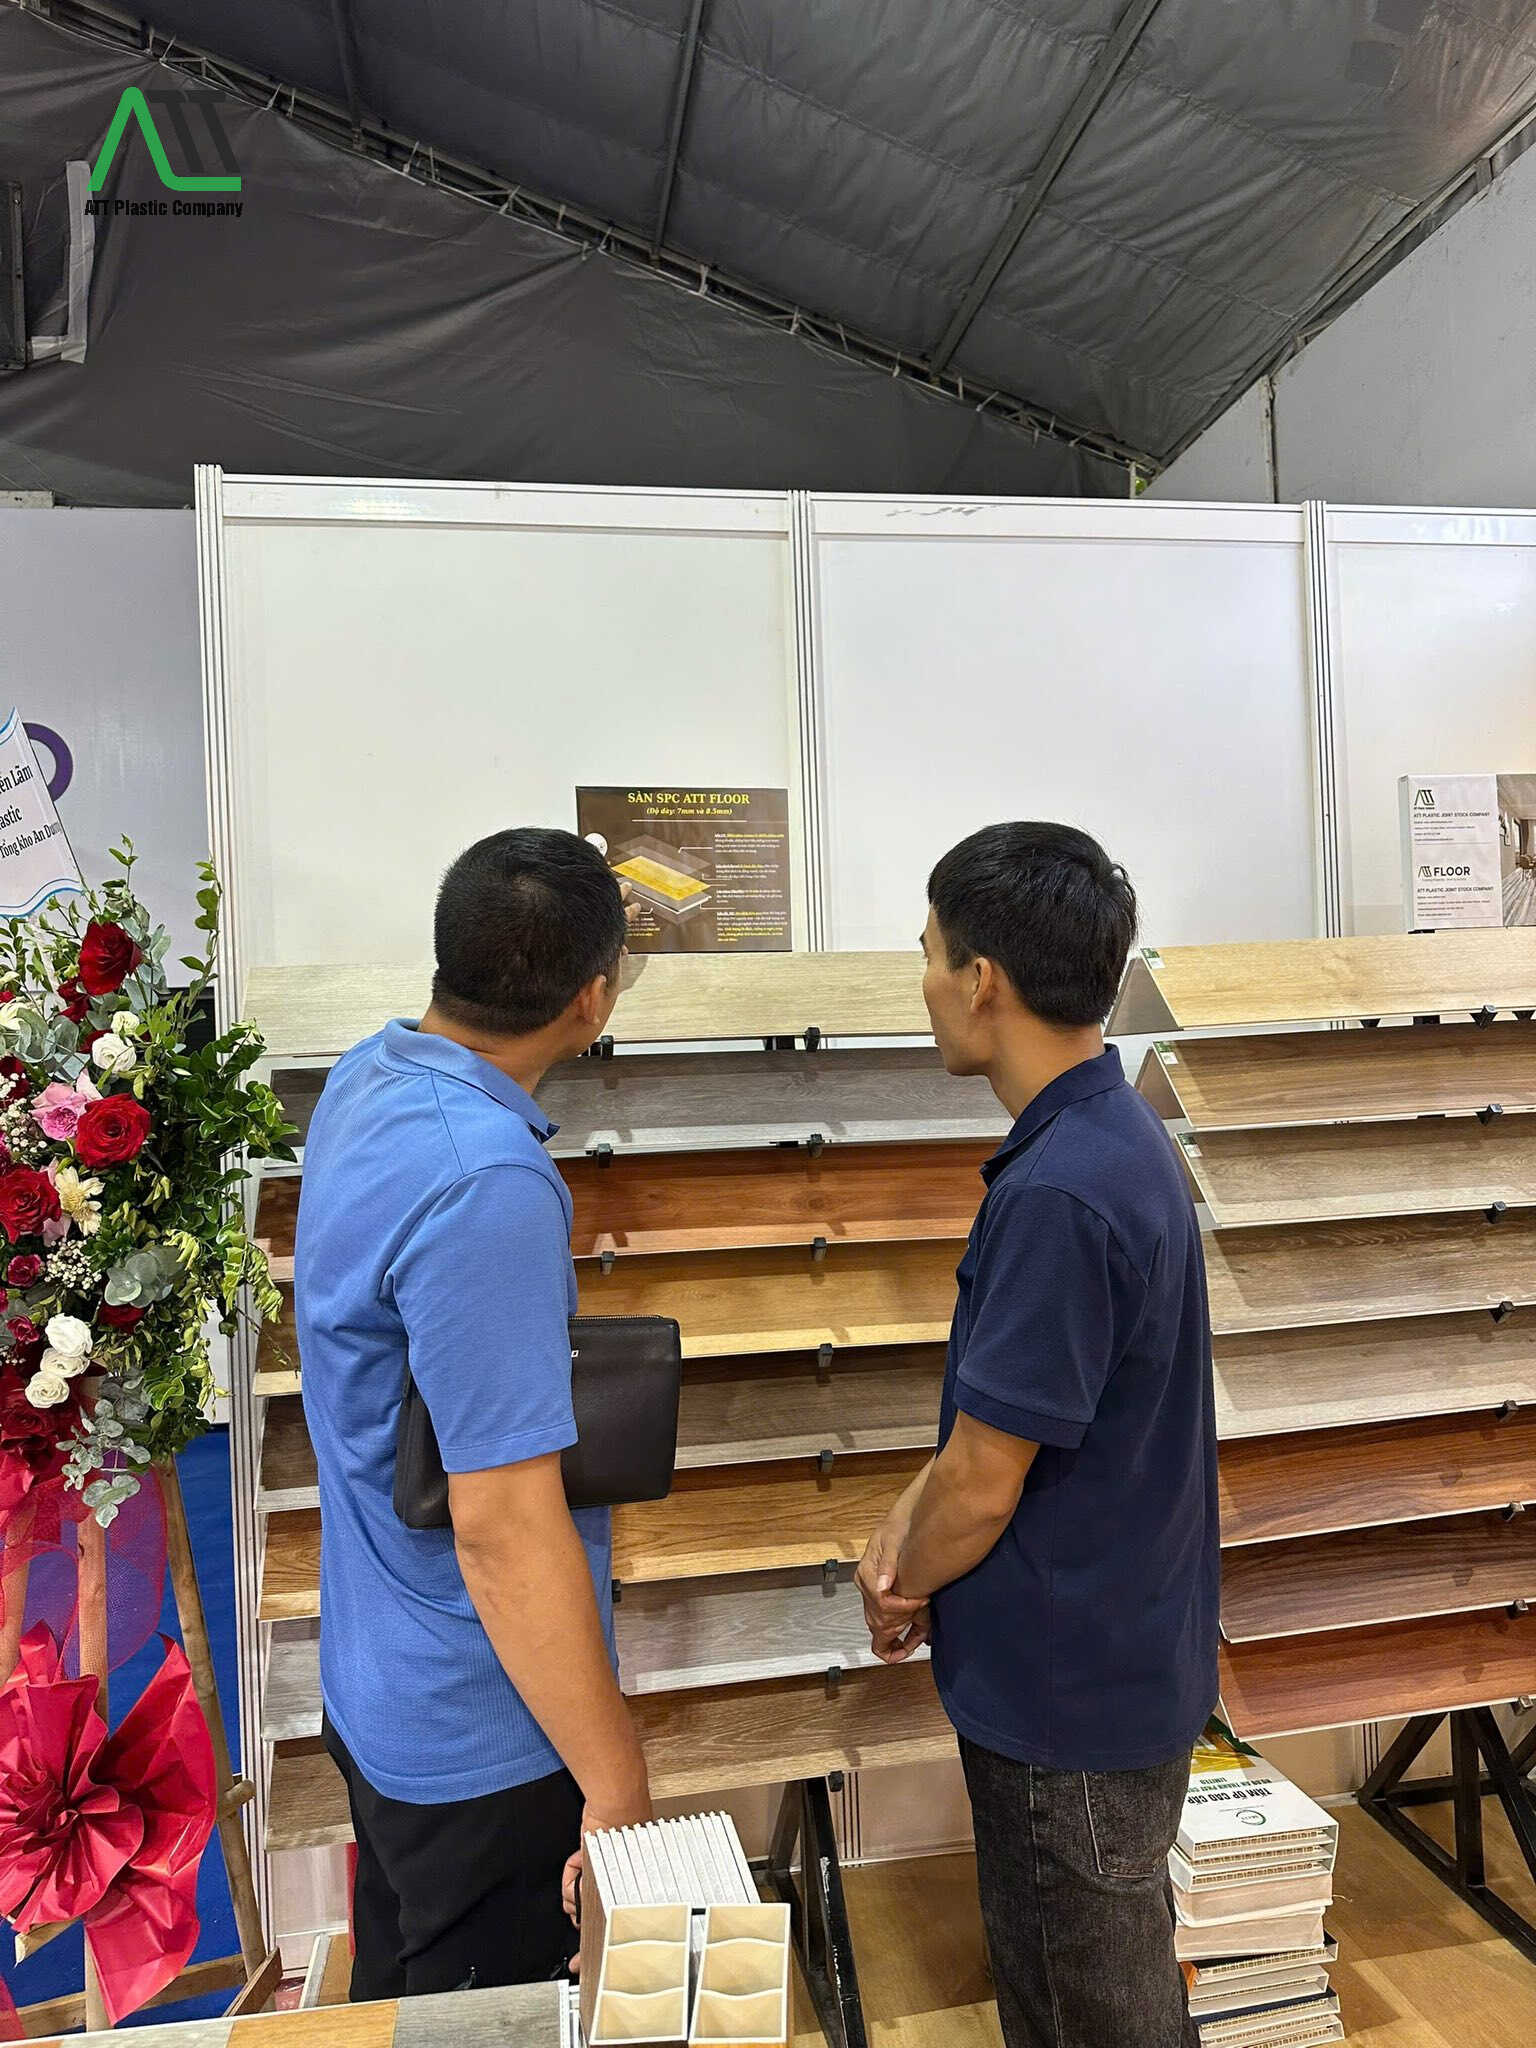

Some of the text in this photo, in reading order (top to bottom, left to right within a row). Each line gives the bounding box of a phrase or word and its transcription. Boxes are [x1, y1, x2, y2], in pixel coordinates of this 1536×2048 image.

[10, 765, 33, 786] Lãm
[628, 790, 750, 804] SÀN SPC ATT FLOOR
[0, 805, 22, 830] astic
[16, 834, 33, 850] kho
[32, 830, 46, 843] An
[1434, 866, 1470, 876] FLOOR
[1208, 1793, 1230, 1801] CAO
